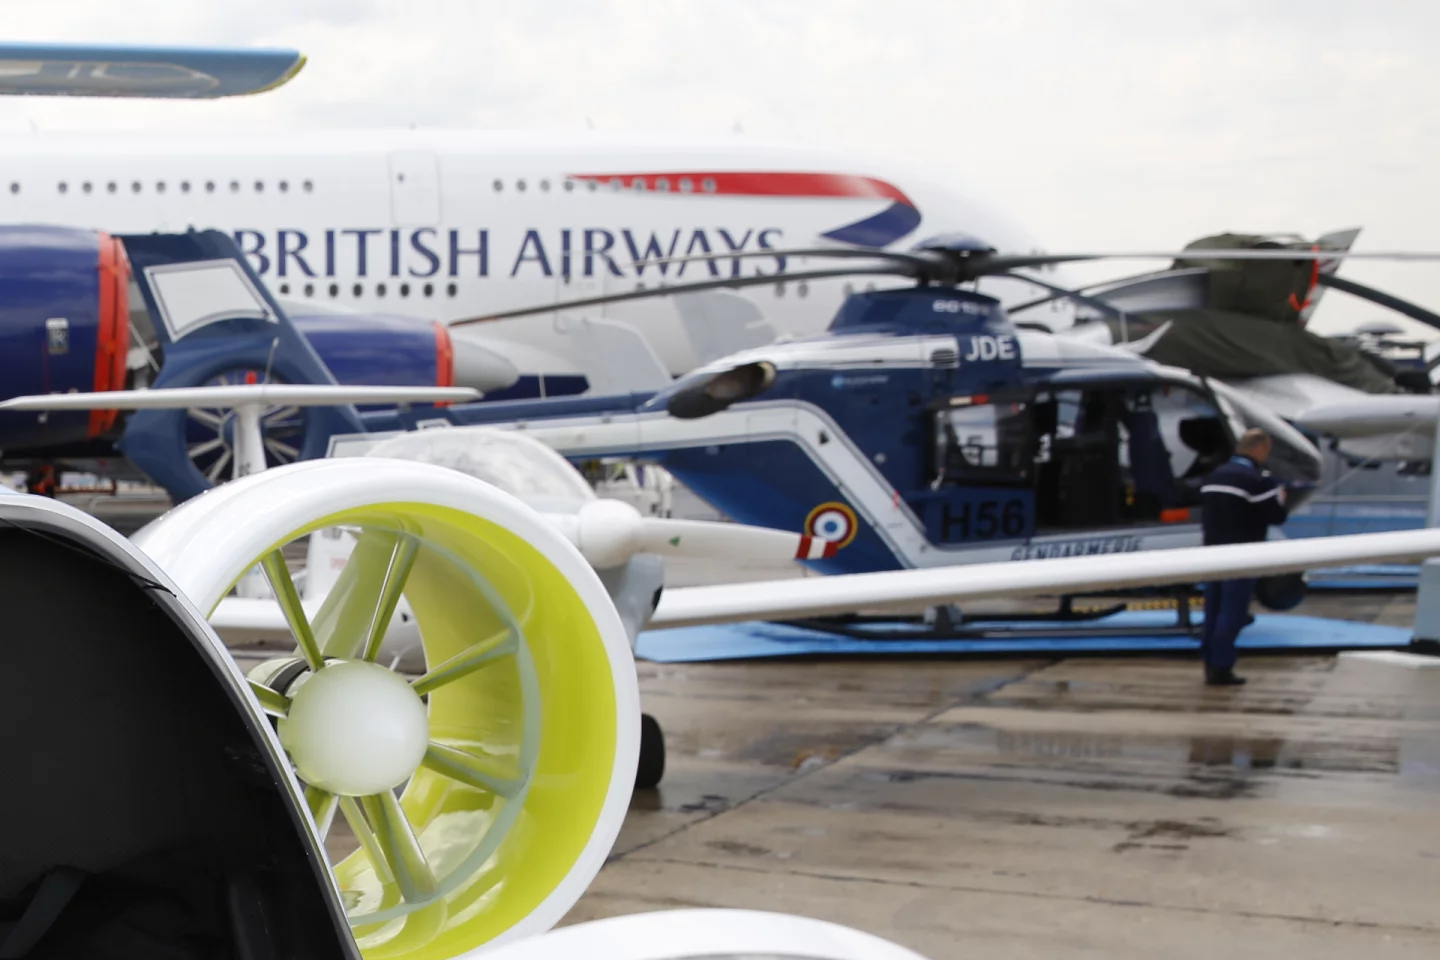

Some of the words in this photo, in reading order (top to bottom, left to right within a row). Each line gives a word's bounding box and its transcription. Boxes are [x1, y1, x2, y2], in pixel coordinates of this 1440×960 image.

[233, 227, 489, 279] BRITISH
[510, 227, 788, 279] AIRWAYS
[965, 335, 1016, 362] JDE
[941, 498, 1025, 541] H56
